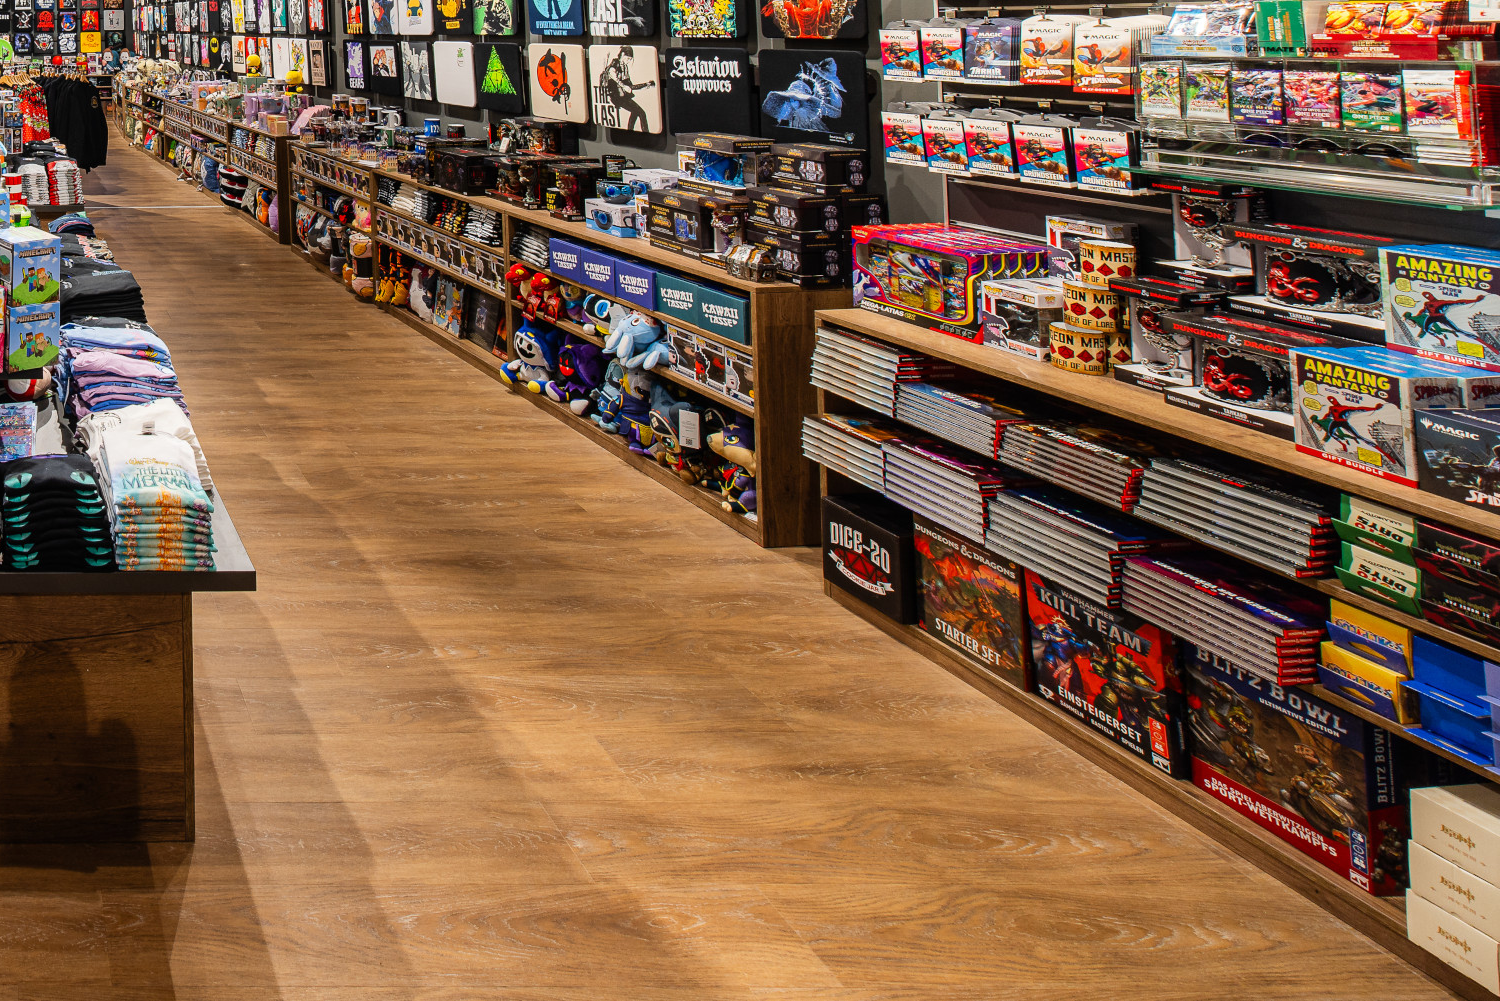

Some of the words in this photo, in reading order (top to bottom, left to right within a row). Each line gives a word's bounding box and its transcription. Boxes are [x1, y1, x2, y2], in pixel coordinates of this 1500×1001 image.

[671, 56, 742, 78] Astarion
[886, 69, 917, 77] GRUNDSTEIN
[927, 68, 960, 77] GRUNDSTEIN
[683, 78, 732, 94] approves
[595, 104, 622, 129] LAST
[1027, 131, 1053, 139] MAGIC
[931, 161, 965, 171] GRUNDSTEIN
[972, 162, 1009, 172] GRUNDSTEIN
[1024, 170, 1064, 181] GRUNDSTEIN
[1234, 230, 1292, 246] DUNGEONS
[1292, 236, 1307, 249] &
[1308, 241, 1365, 256] DRAGONS
[19, 247, 57, 258] MINECRAFT
[552, 250, 578, 265] KAWAII
[554, 260, 574, 270] TASSE
[583, 261, 611, 277] KAWAII
[1396, 256, 1493, 281] AMAZING
[586, 271, 607, 281] TASSE
[618, 273, 649, 288] KAWAII
[1408, 270, 1477, 288] FANTASY
[623, 284, 645, 294] TASSE
[660, 286, 694, 303] KAWAII
[1438, 286, 1462, 294] SPIDER
[665, 299, 688, 310] TASSE
[1250, 306, 1265, 315] NOW
[16, 312, 56, 324] MINECRAFT
[1173, 322, 1227, 342] DUNGEONS
[1227, 333, 1243, 347] &
[1243, 340, 1289, 356] DRAGON
[1416, 349, 1439, 360] GIFT
[1442, 353, 1487, 367] BUNDLE
[1084, 363, 1103, 371] LORE
[1304, 358, 1390, 390] AMAZING
[1316, 373, 1377, 397] FANTASY
[1341, 391, 1363, 401] SPIDER
[1432, 424, 1480, 441] MAGIC
[1321, 452, 1342, 462] GIFT
[1346, 457, 1384, 476] BUNDLE
[830, 521, 890, 574] DICE-20
[914, 523, 959, 553] DUNGEONS
[960, 544, 973, 560] &
[972, 553, 1016, 579] DRAGONS
[1060, 589, 1115, 621] WARHAMMER
[1039, 587, 1079, 621] KILL
[1085, 606, 1142, 653] TEAM
[935, 618, 980, 653] STARTER
[982, 646, 1001, 666] SET
[1196, 647, 1262, 693] BLITZ
[1268, 683, 1347, 734] BOWL
[1057, 686, 1142, 743] EINSTEIGERSET
[1258, 697, 1305, 725] ULTIMATIVE
[1308, 718, 1340, 738] EDITION
[1059, 700, 1084, 719] SAMMELN
[1090, 718, 1114, 737] BASTELN
[1121, 737, 1144, 755] SPIELEN
[1203, 777, 1338, 857] SPORT-WETTKAMPFS
[1211, 776, 1230, 792] DAS
[1229, 783, 1253, 804] SPIEL
[1254, 798, 1325, 843] ABERWITZIGEN
